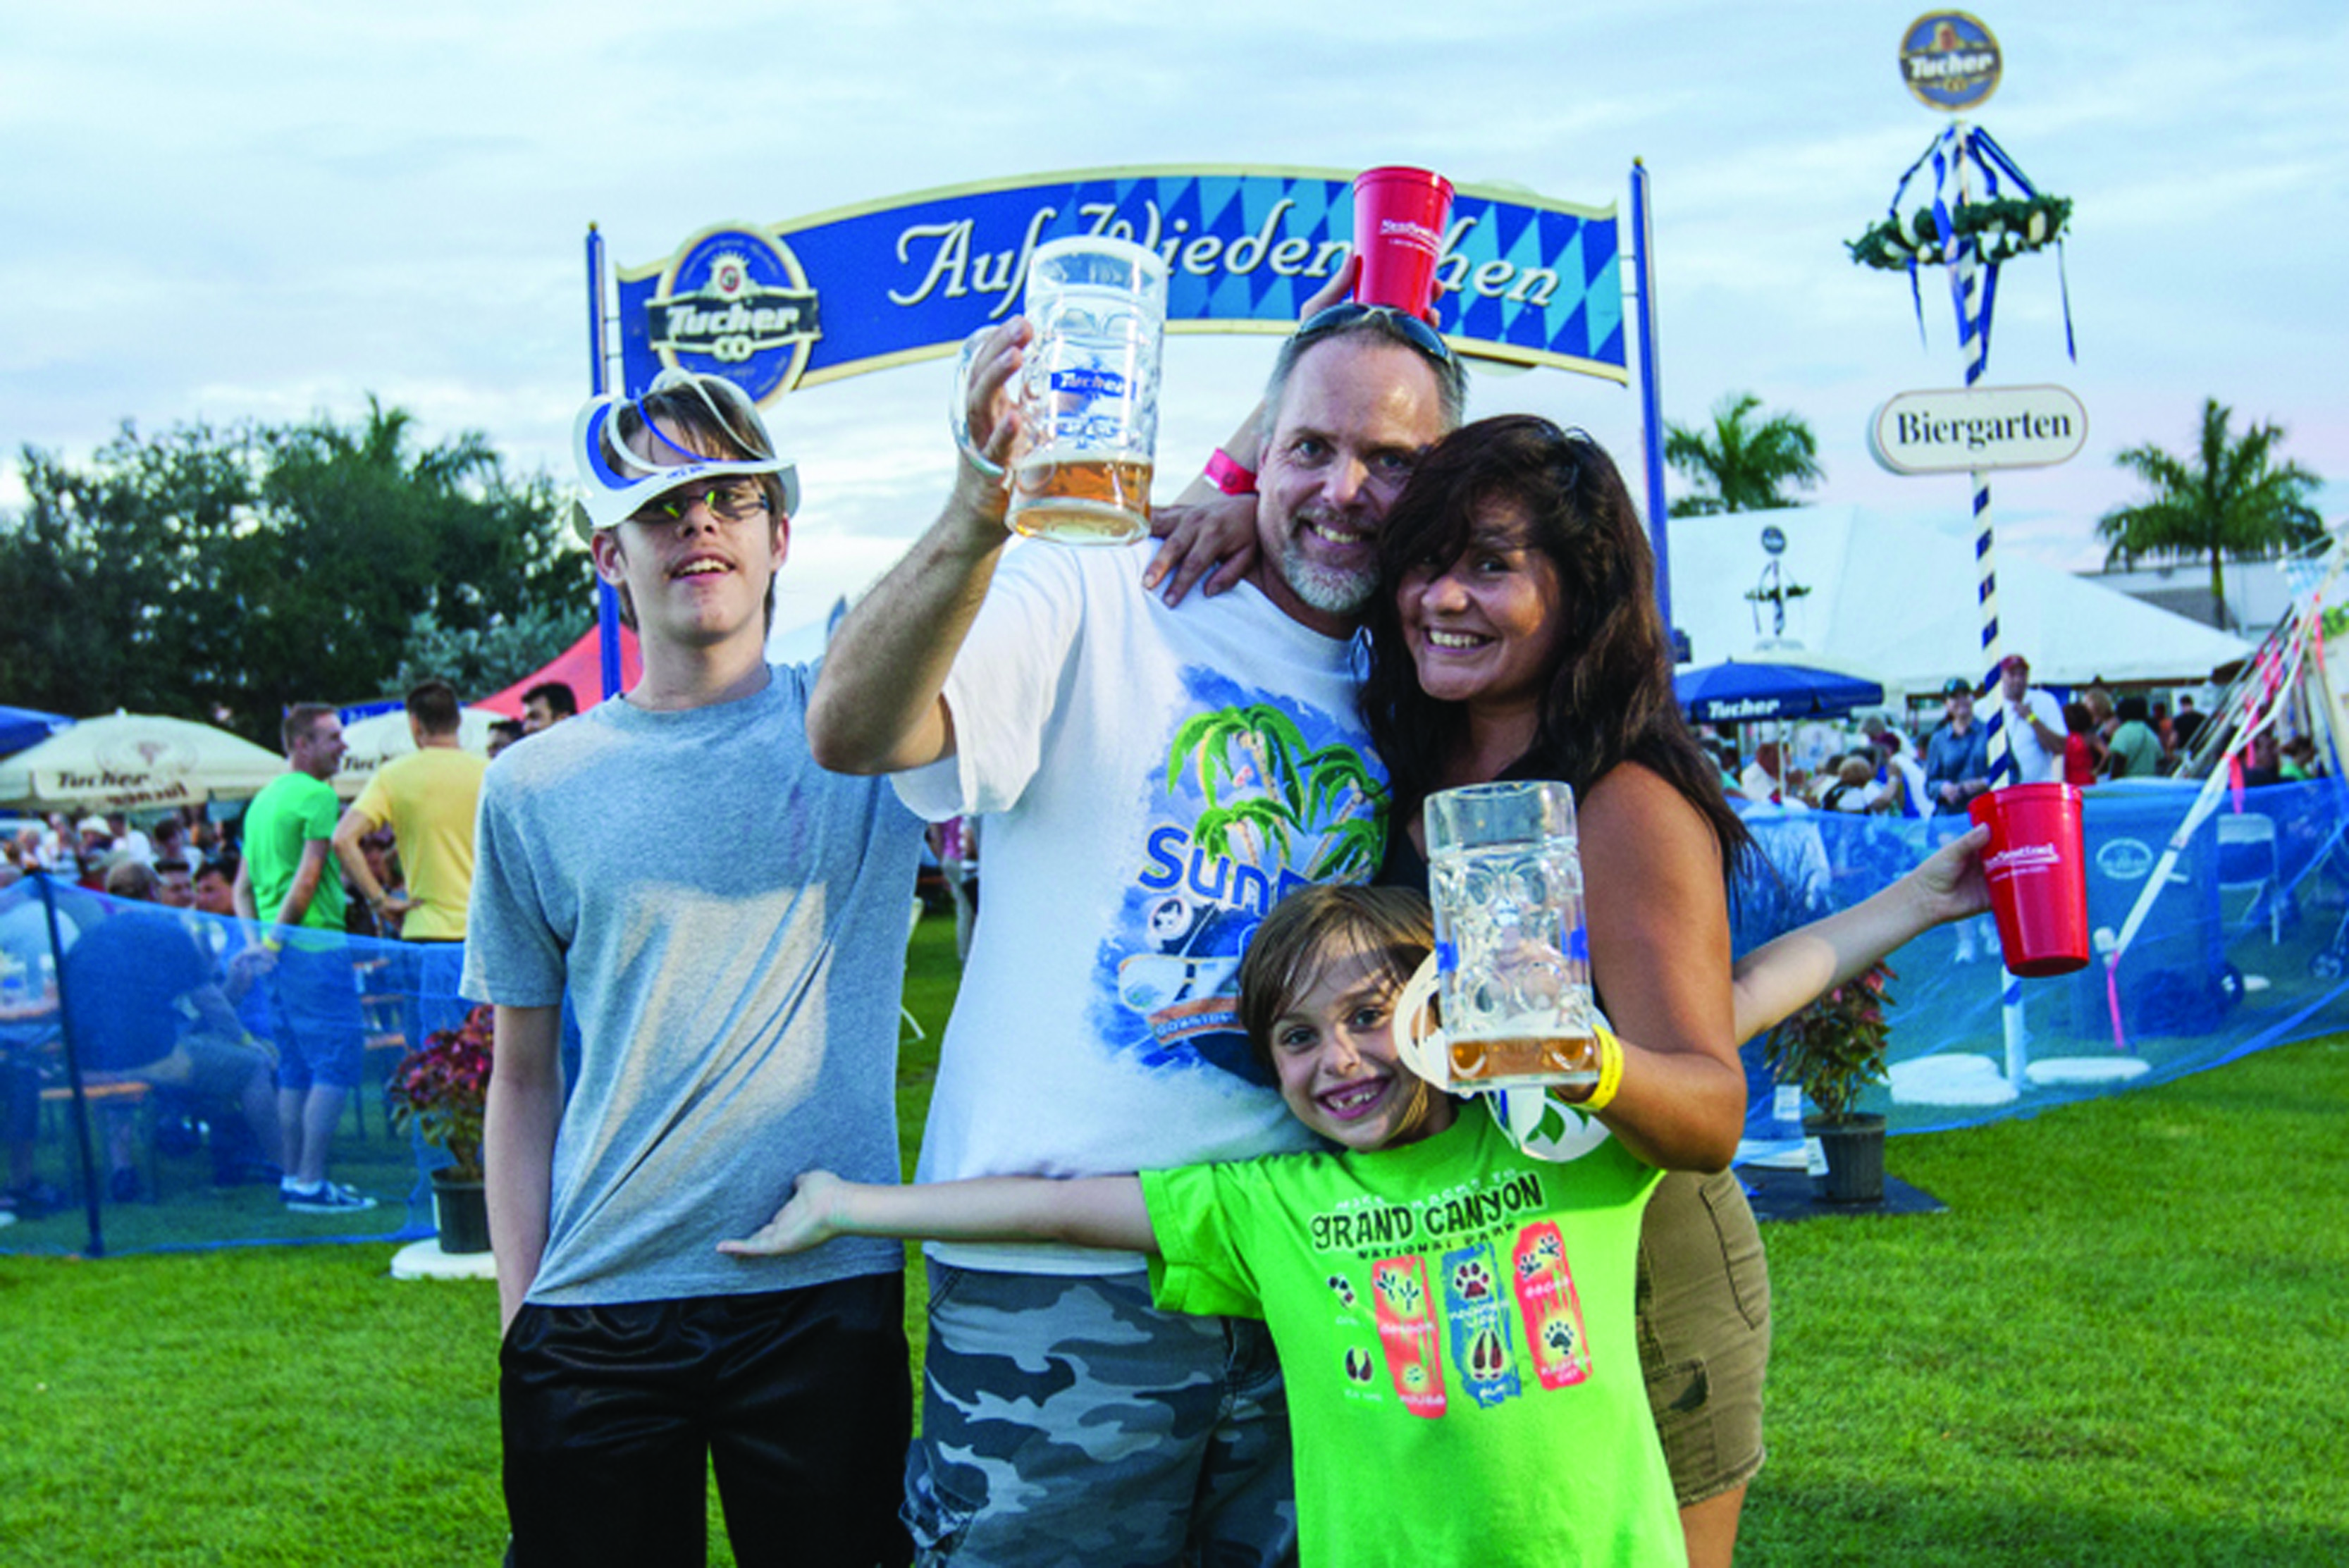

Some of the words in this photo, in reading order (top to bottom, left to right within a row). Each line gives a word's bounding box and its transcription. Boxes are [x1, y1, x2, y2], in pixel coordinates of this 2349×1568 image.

[1909, 53, 1993, 79] Tucher
[887, 205, 1056, 319] Auf
[666, 301, 800, 341] Tucher
[1897, 409, 2071, 450] Biergarten
[1708, 698, 1780, 720] Tucher
[57, 770, 150, 788] Tucher
[1424, 1173, 1543, 1235] CANYON
